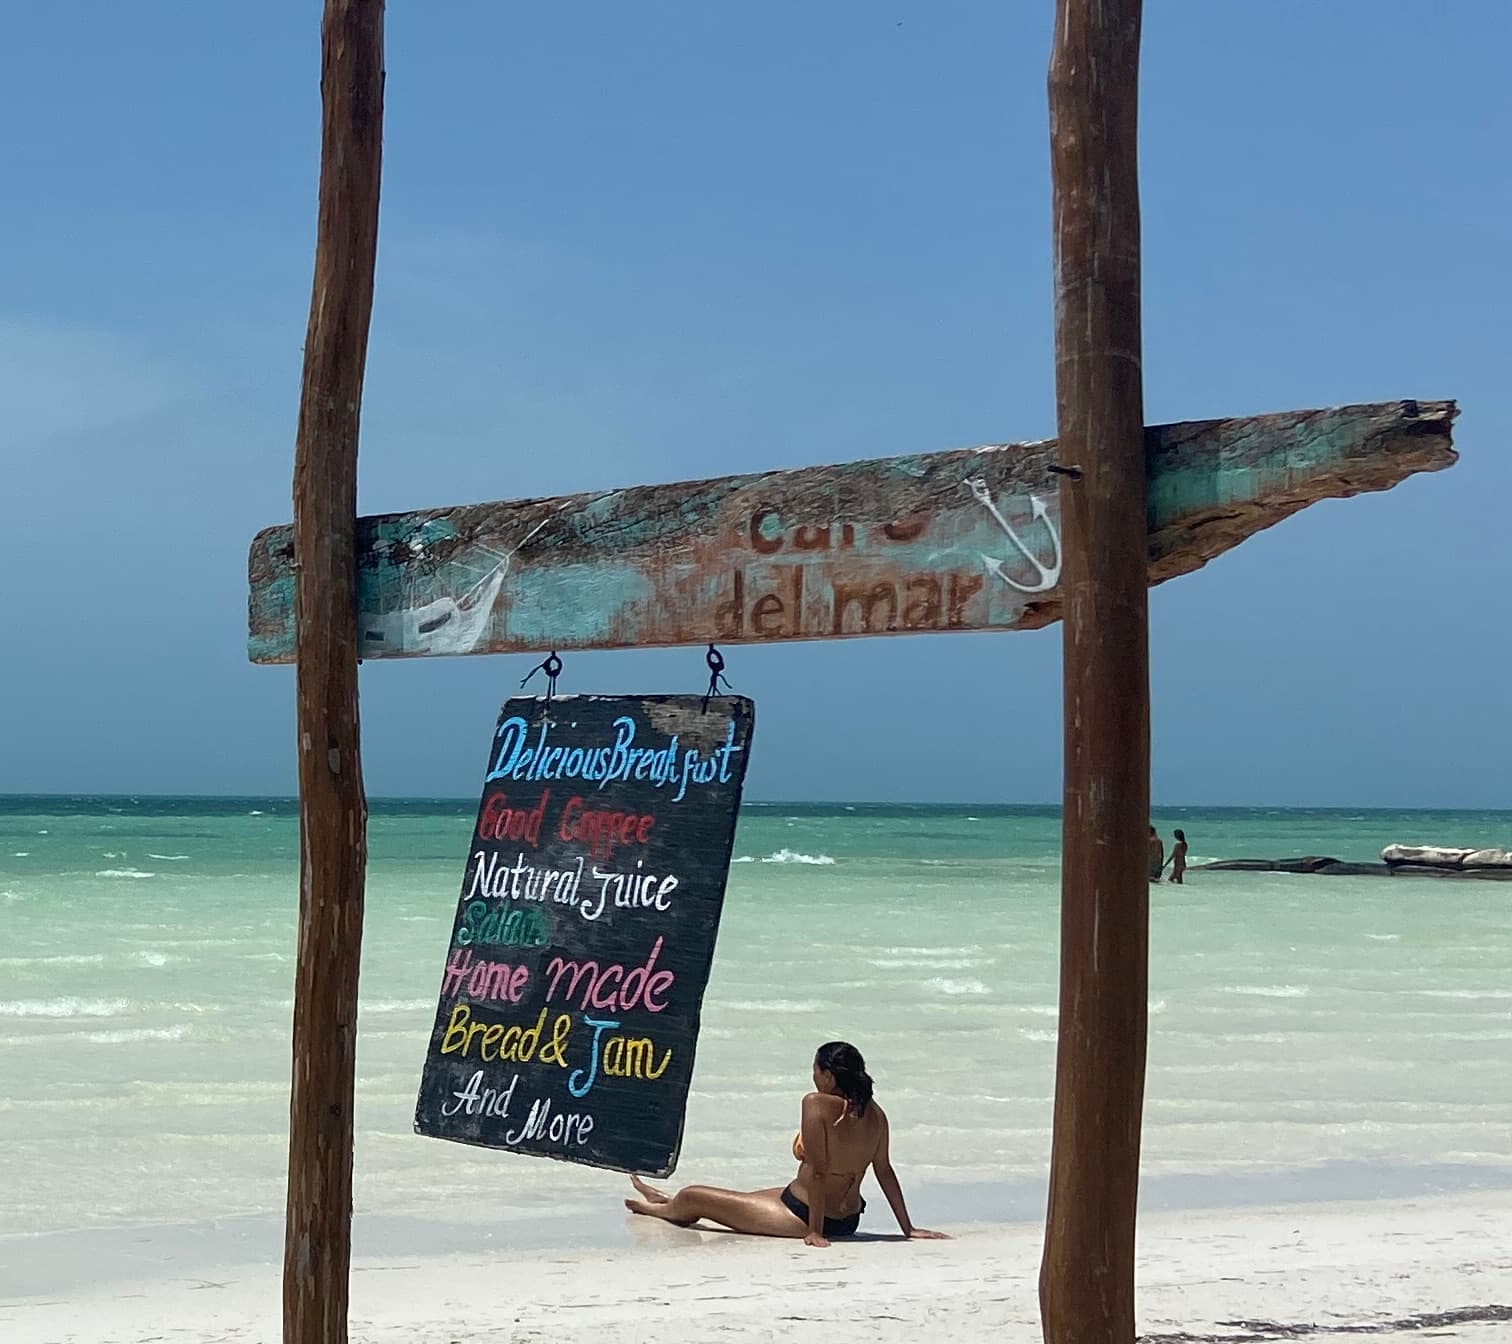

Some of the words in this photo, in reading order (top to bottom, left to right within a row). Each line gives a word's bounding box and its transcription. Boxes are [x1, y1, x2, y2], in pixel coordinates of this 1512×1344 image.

[714, 565, 803, 636] del
[834, 573, 984, 631] mar
[478, 788, 550, 847] Good
[464, 851, 585, 905] Natural
[580, 861, 678, 920] Juice
[442, 949, 529, 1002] Home
[568, 1014, 671, 1097] Jam
[441, 1070, 518, 1116] And
[505, 1098, 594, 1145] More
